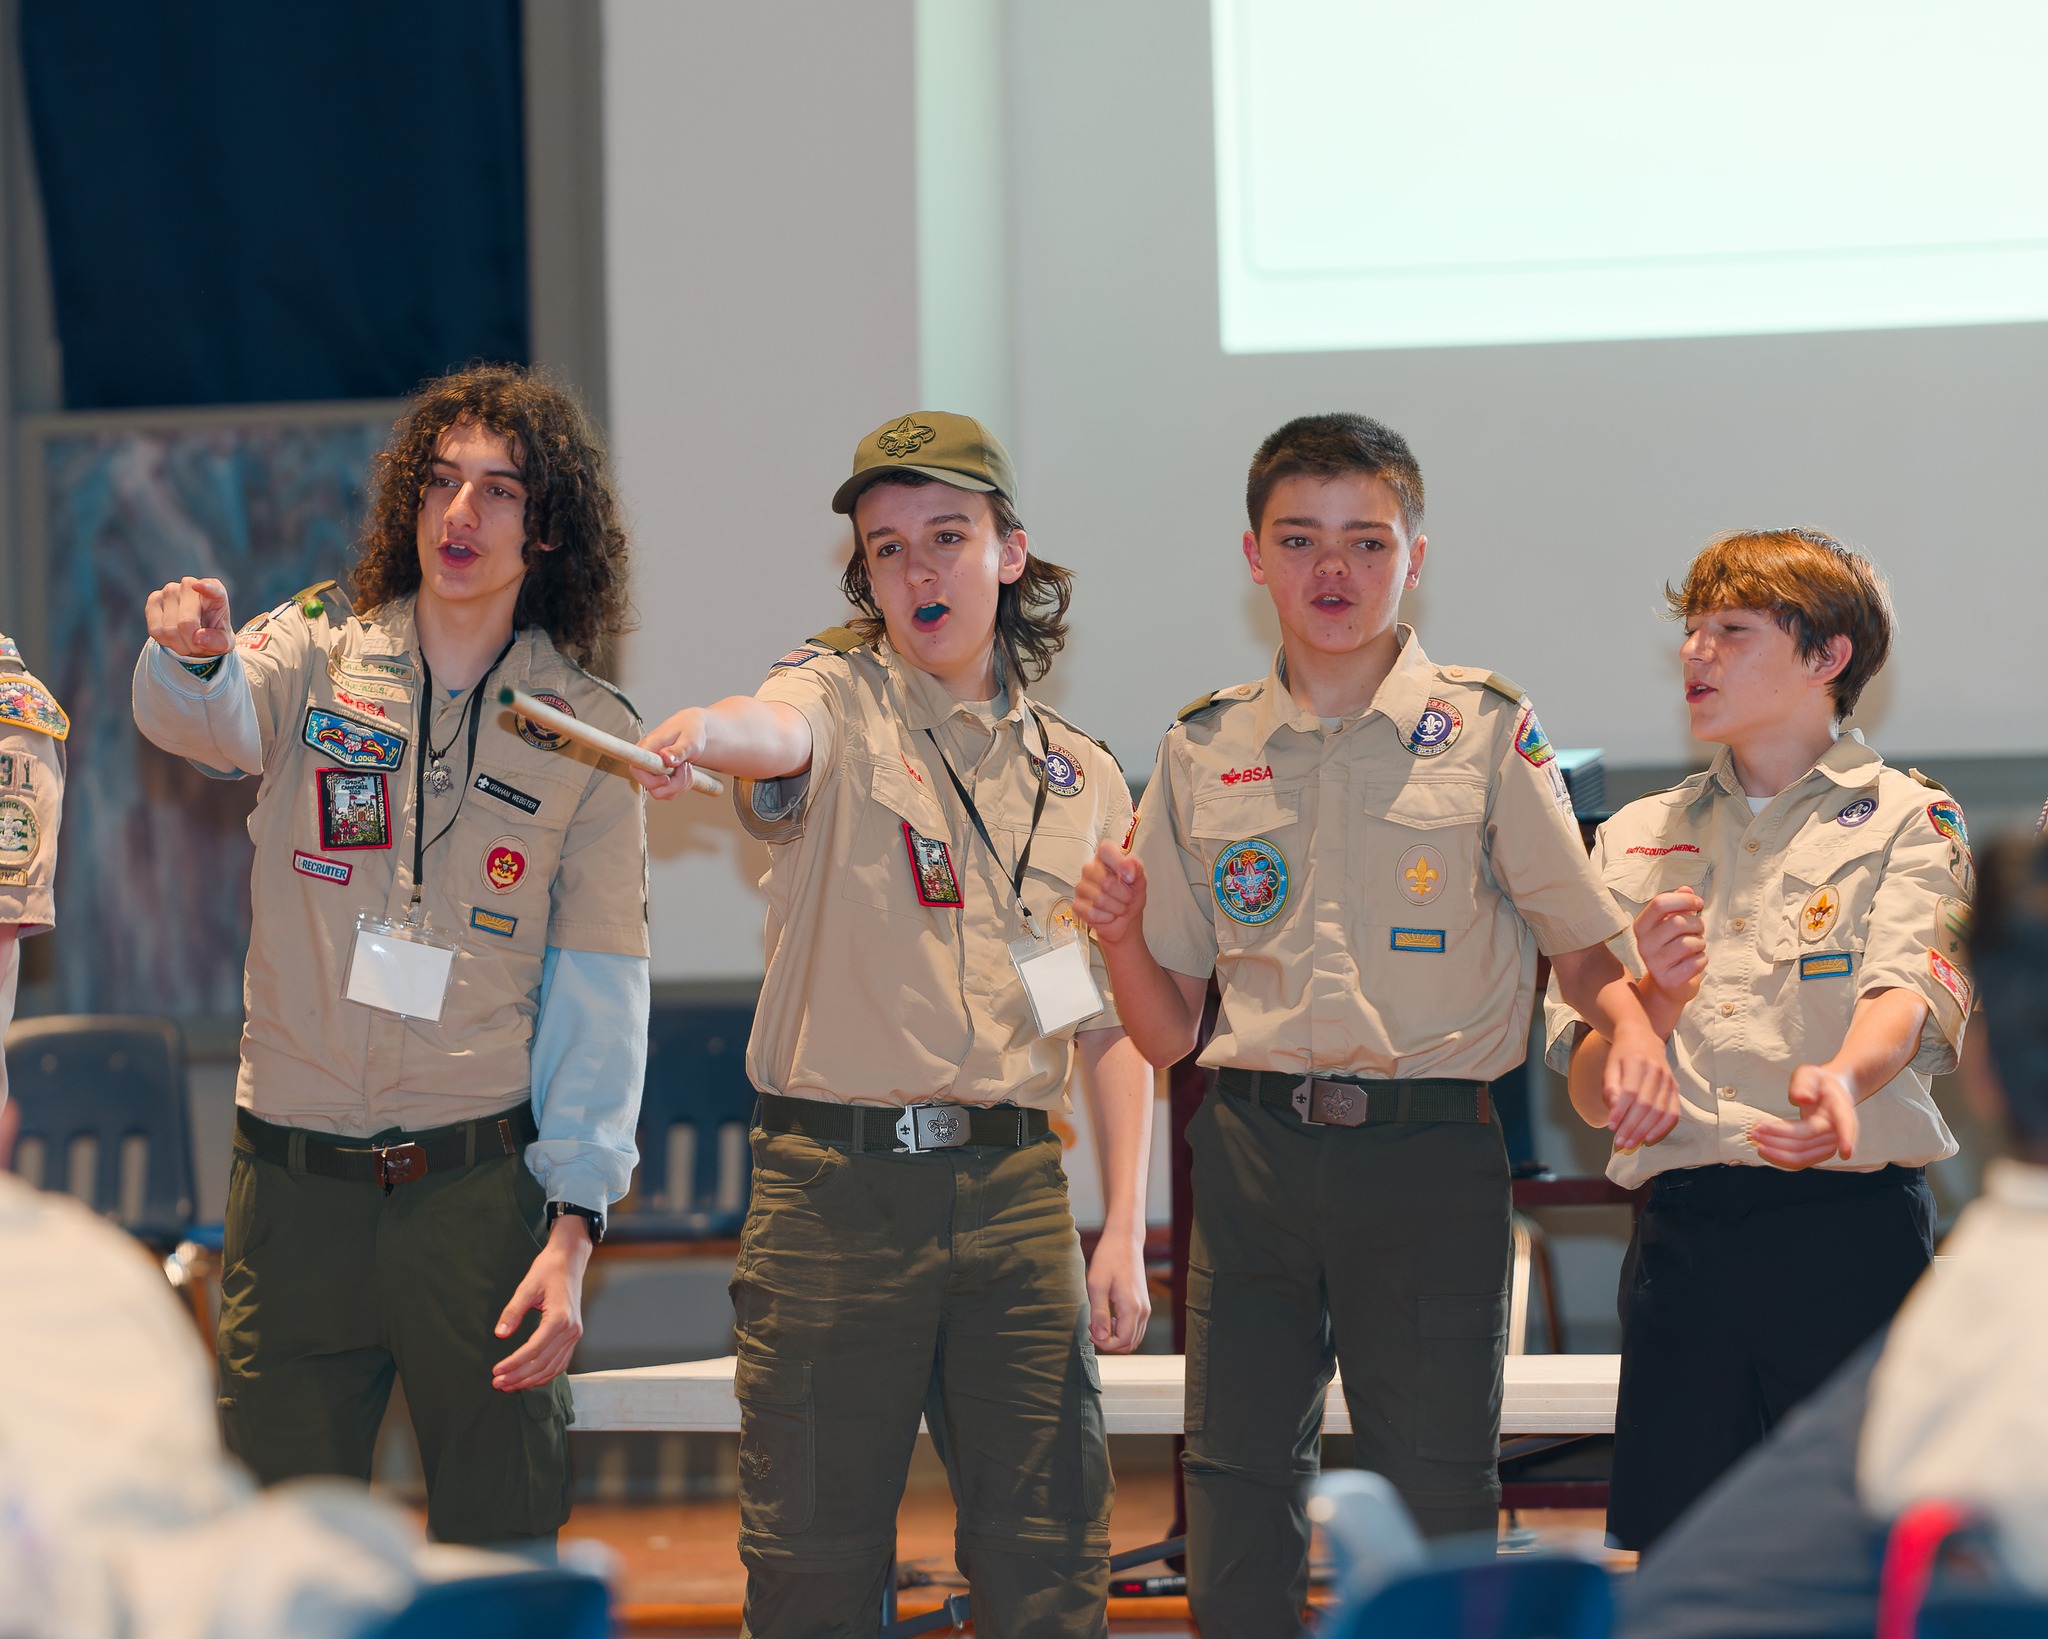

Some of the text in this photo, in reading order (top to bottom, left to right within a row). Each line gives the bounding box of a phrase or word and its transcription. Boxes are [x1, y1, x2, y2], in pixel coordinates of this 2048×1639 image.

[378, 664, 407, 676] STAFF
[356, 700, 386, 718] BSA
[322, 740, 347, 760] SKYUKA
[354, 755, 377, 763] LODGE
[1241, 765, 1273, 783] BSA
[489, 783, 537, 810] GRAHAM WEBSTER
[302, 859, 347, 880] RECRUITER
